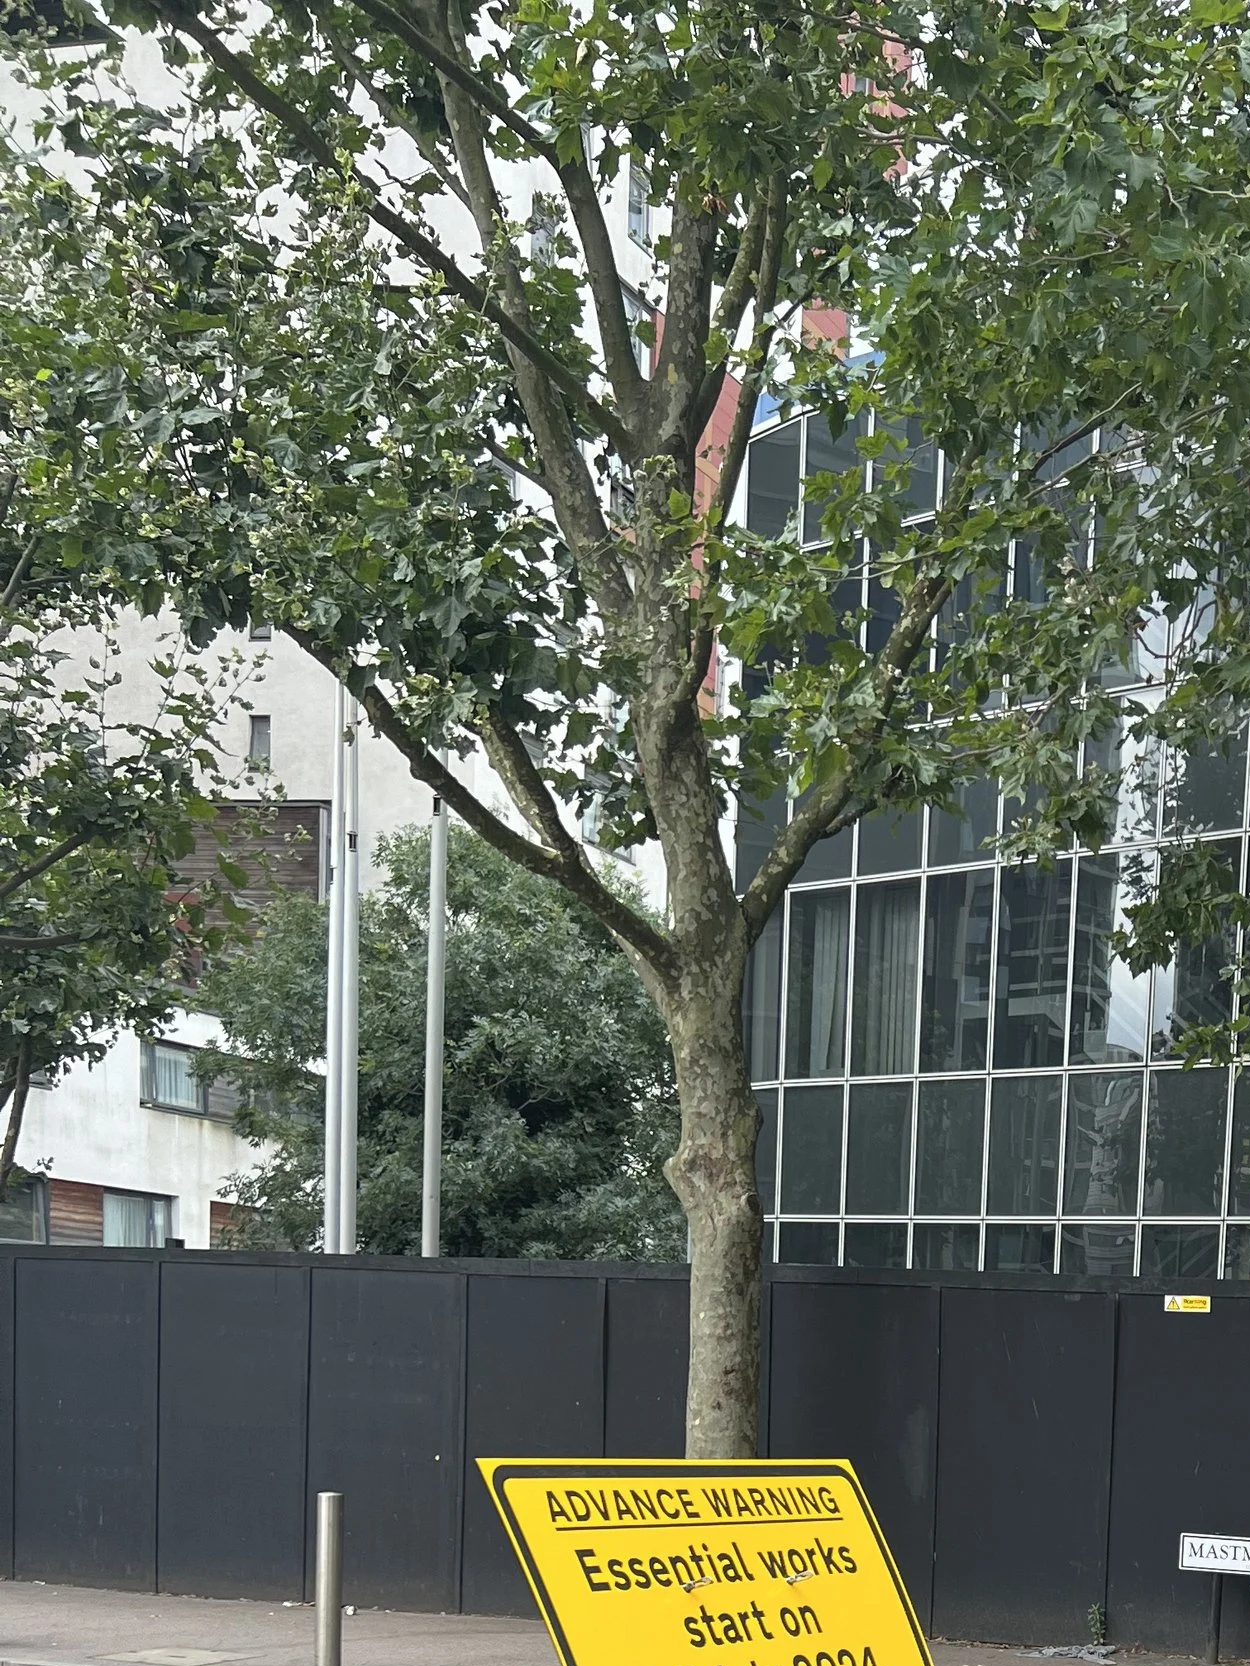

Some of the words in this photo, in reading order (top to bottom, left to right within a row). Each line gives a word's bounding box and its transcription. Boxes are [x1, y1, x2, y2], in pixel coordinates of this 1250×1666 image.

[546, 1489, 700, 1523] ADVANCE
[701, 1486, 841, 1518] WARNING
[574, 1541, 755, 1592] Essential
[757, 1537, 858, 1580] works
[684, 1600, 775, 1648] start
[780, 1605, 823, 1638] on
